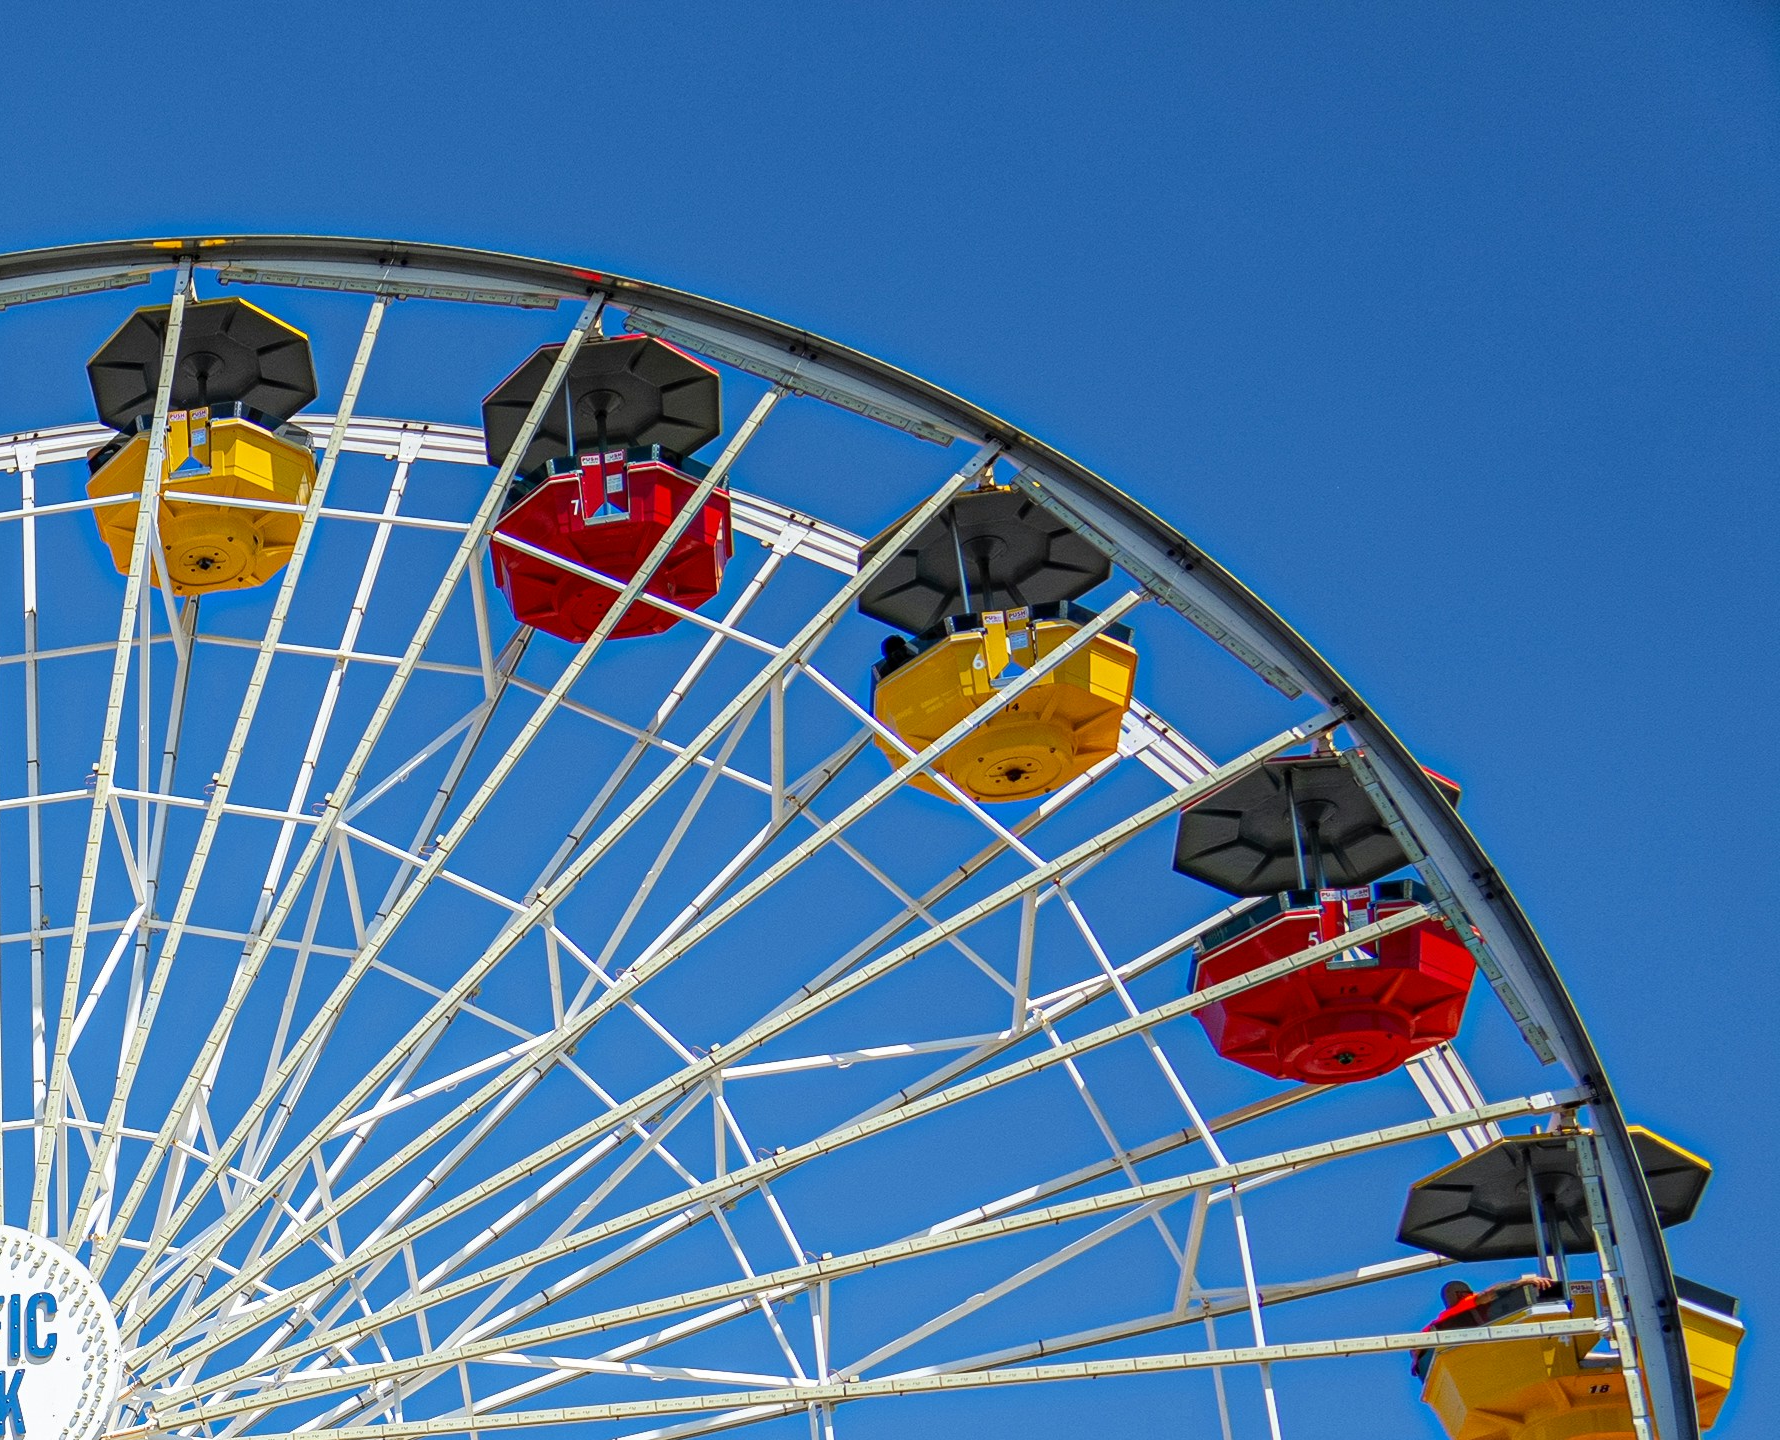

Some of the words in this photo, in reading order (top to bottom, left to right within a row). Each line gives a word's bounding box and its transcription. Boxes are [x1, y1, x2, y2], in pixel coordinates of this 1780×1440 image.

[570, 499, 579, 515] 7
[972, 653, 985, 670] 6
[1308, 931, 1319, 949] 5
[1589, 1384, 1610, 1394] 18
